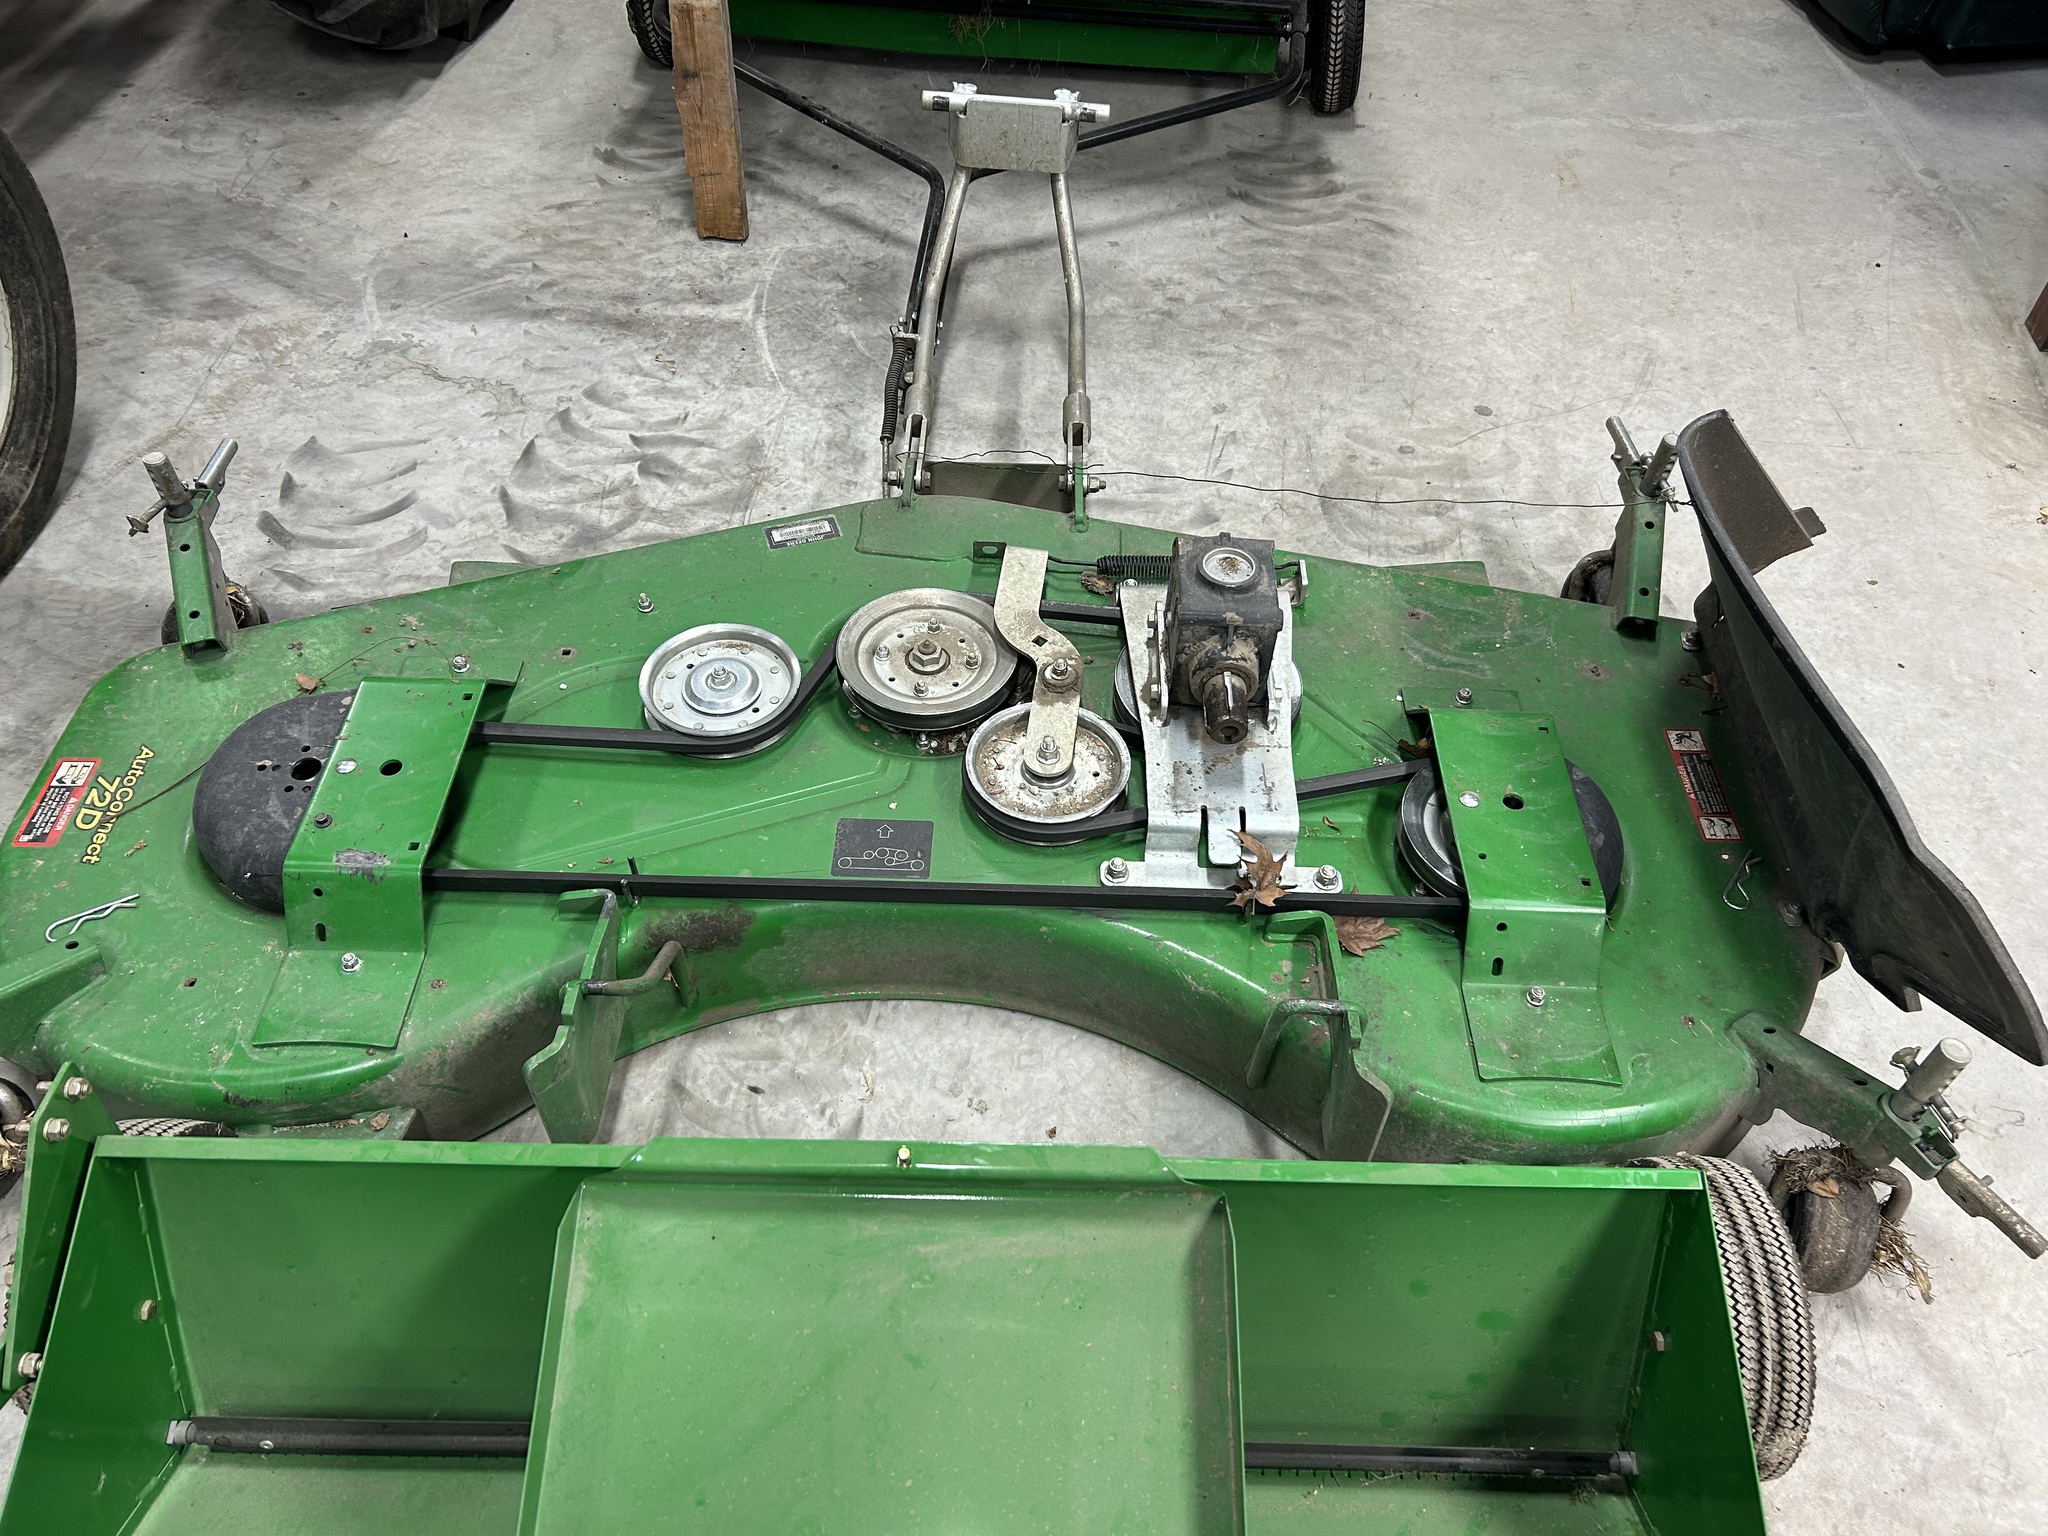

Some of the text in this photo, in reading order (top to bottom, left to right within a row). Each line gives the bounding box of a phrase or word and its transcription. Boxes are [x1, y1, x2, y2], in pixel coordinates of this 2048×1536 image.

[1677, 765, 1692, 792] DANGER
[42, 791, 70, 833] ROTATING BLADE
[54, 803, 74, 830] DANGER
[75, 776, 121, 830] 72D
